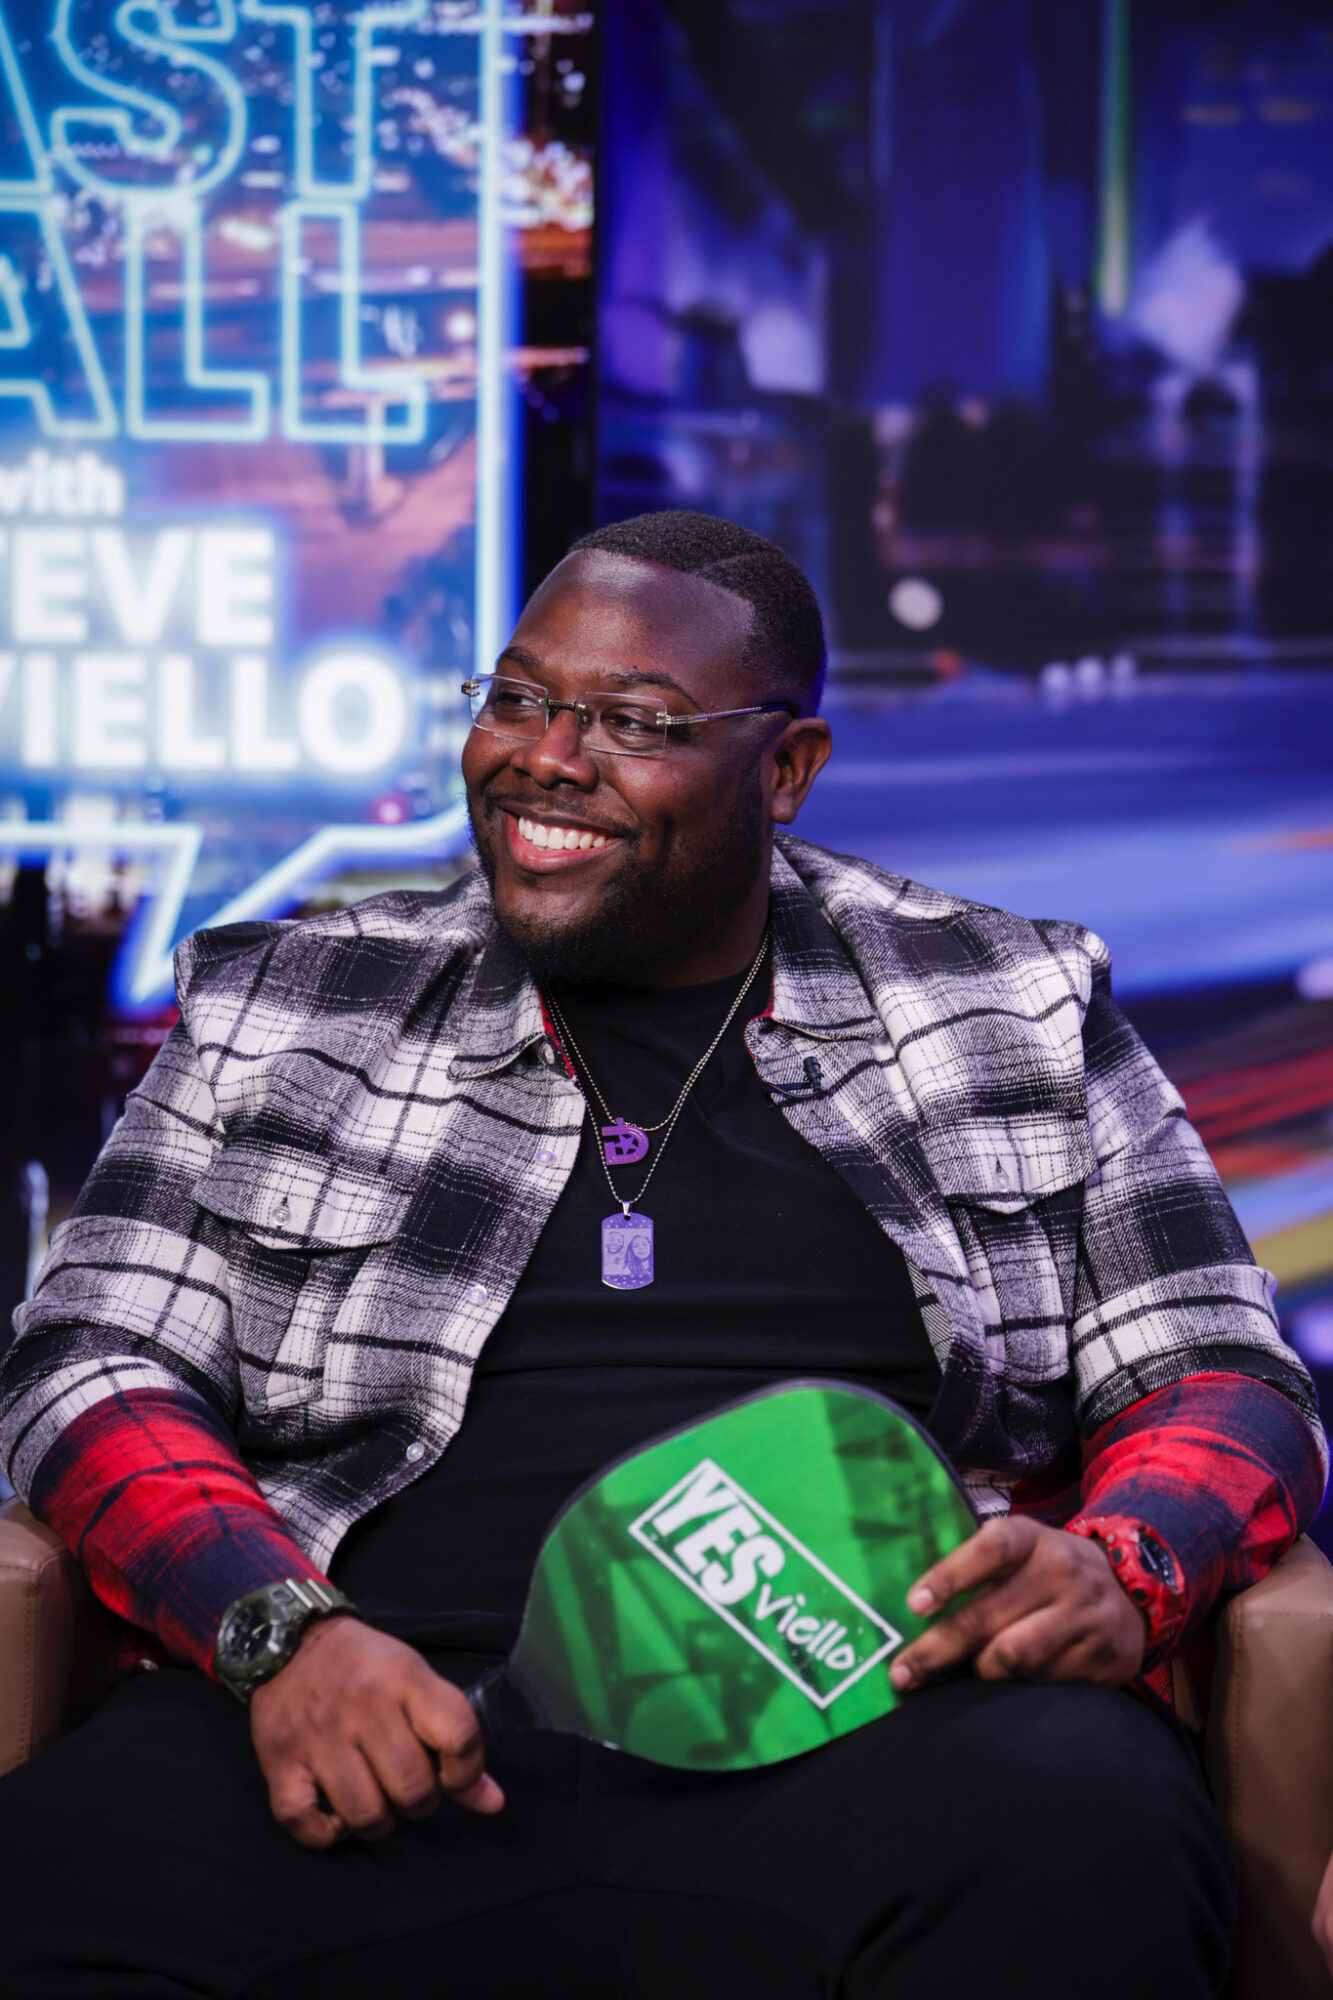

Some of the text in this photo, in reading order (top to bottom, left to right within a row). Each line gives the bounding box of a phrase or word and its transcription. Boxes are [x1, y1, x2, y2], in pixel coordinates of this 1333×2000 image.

[0, 0, 428, 200] ST
[0, 526, 276, 646] EVE
[0, 651, 407, 773] IELLO
[651, 1464, 856, 1671] YES viello
